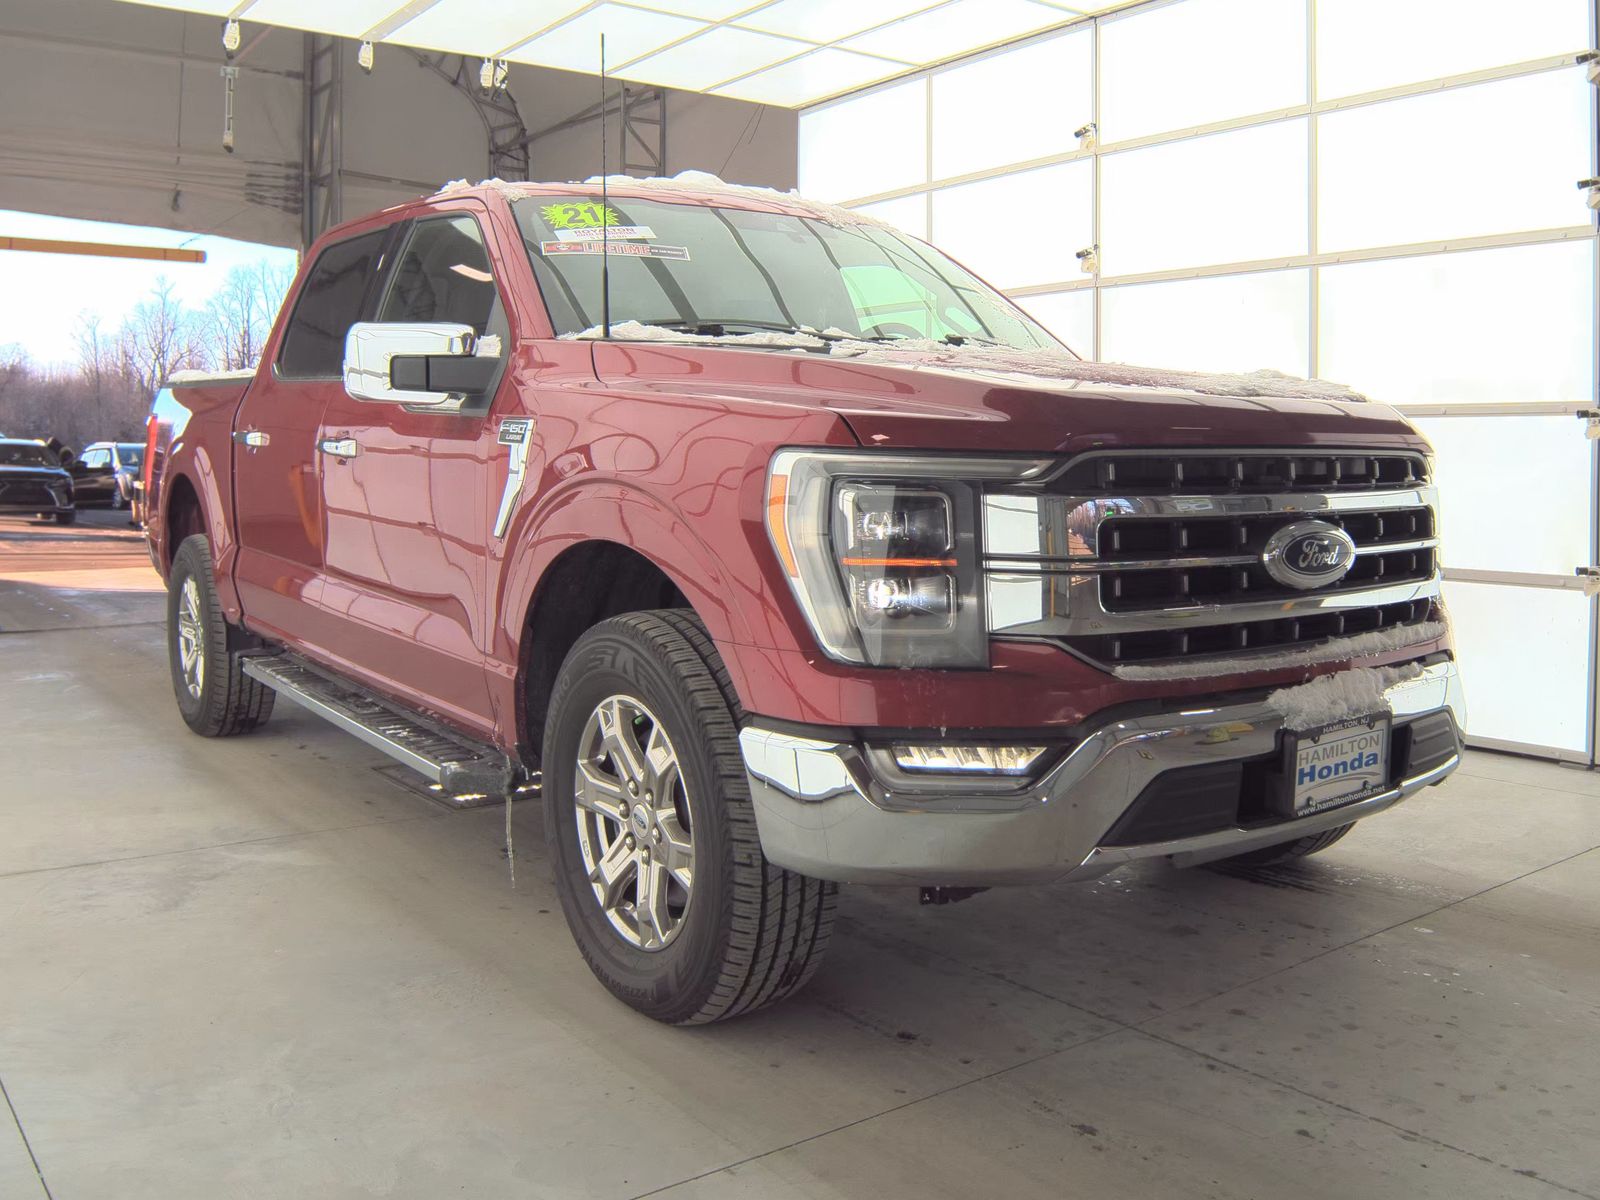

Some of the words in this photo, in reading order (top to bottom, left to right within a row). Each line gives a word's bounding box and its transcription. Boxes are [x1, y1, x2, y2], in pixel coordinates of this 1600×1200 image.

[562, 206, 601, 224] 21
[1298, 539, 1339, 568] Ford
[1298, 734, 1380, 767] HAMILTON
[1297, 751, 1378, 786] Honda
[1297, 785, 1386, 817] www.hamiltonhonda.net
